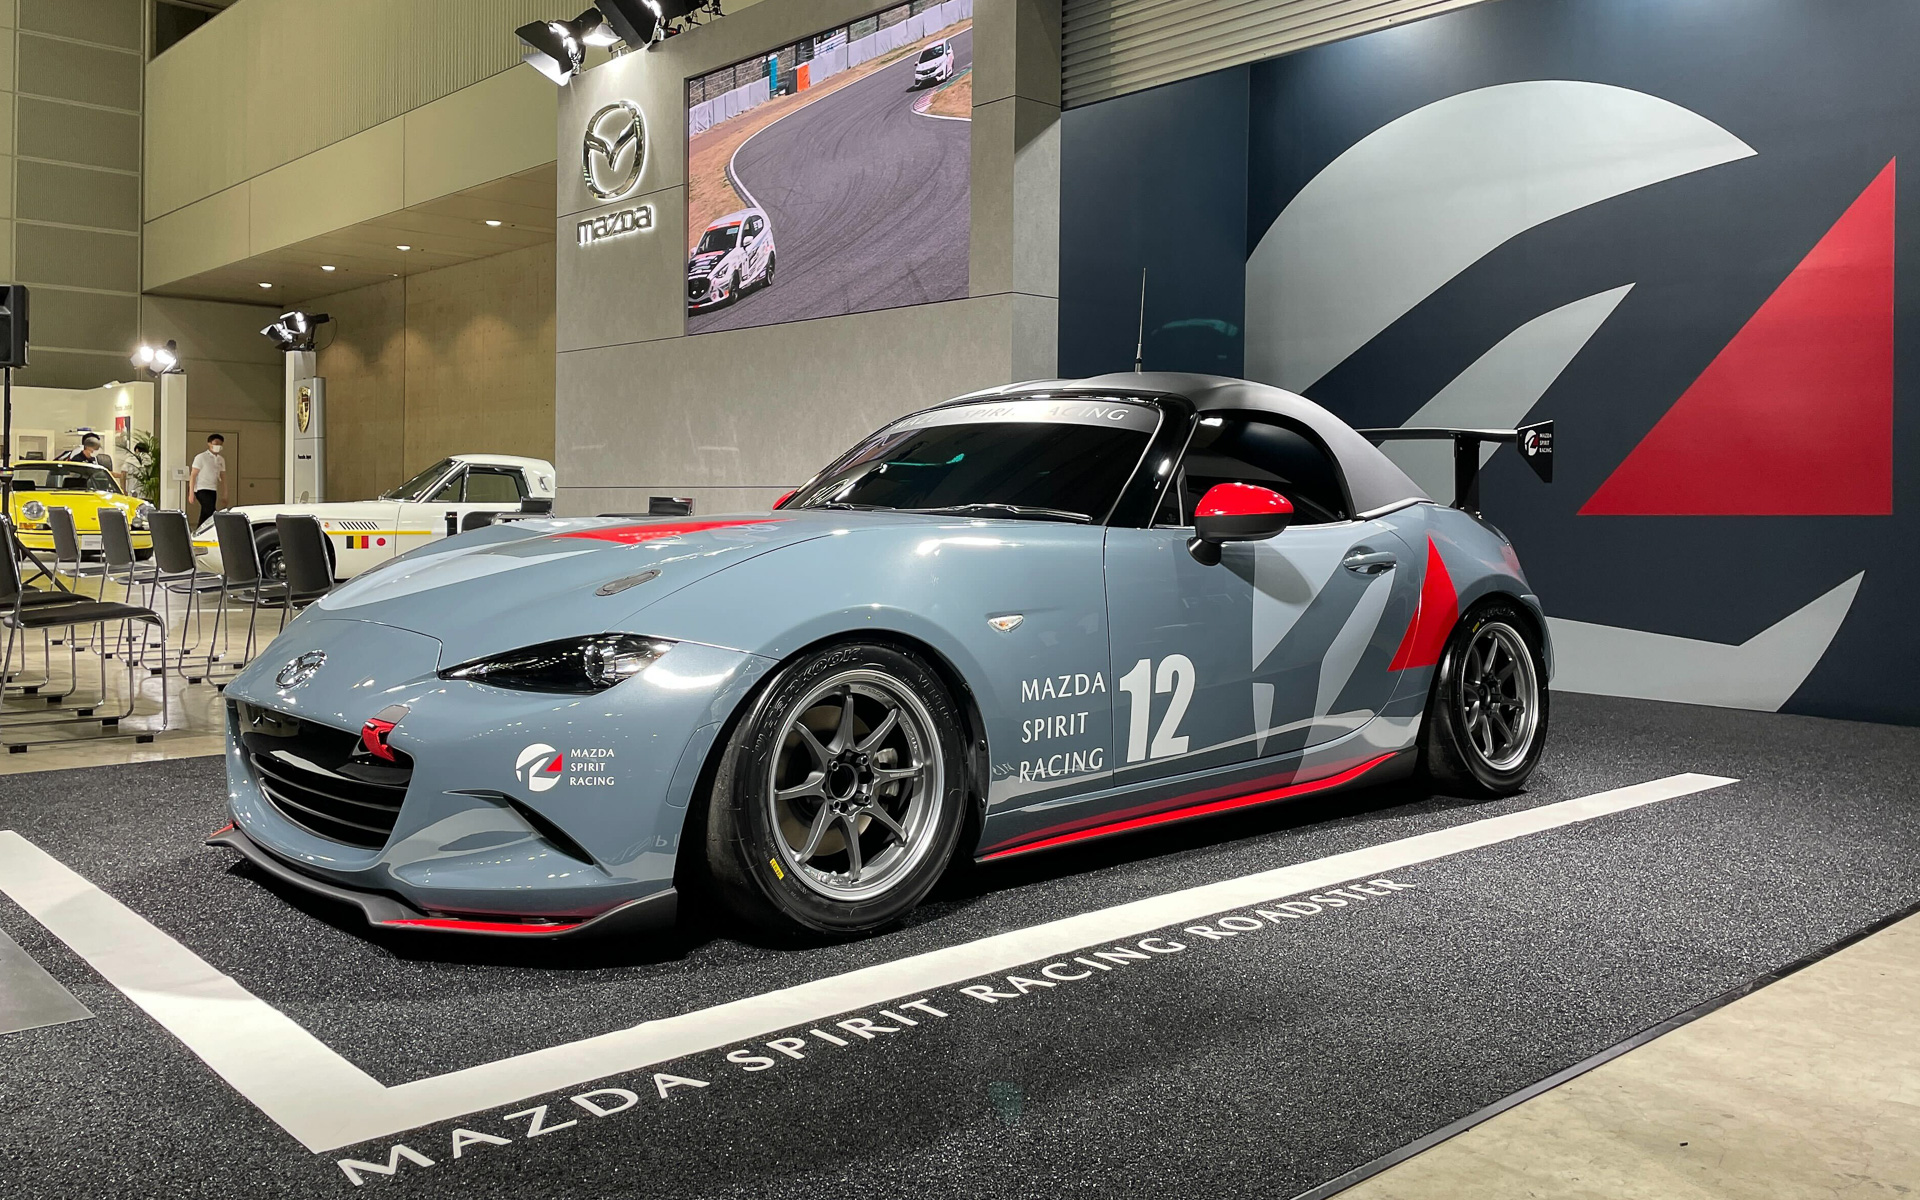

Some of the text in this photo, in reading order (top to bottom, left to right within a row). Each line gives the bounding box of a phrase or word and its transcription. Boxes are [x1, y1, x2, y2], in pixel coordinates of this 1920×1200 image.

[577, 205, 653, 243] mazda
[1046, 405, 1129, 421] ACING
[1021, 671, 1106, 703] MAZDA
[1119, 653, 1196, 763] 12
[1021, 711, 1089, 744] SPIRIT
[570, 748, 615, 758] MAZDA
[570, 762, 606, 772] SPIRIT
[1018, 747, 1104, 784] RACING
[569, 776, 615, 786] RACING
[336, 877, 1418, 1187] MAZDA SPIRIT RACING ROADSTER
